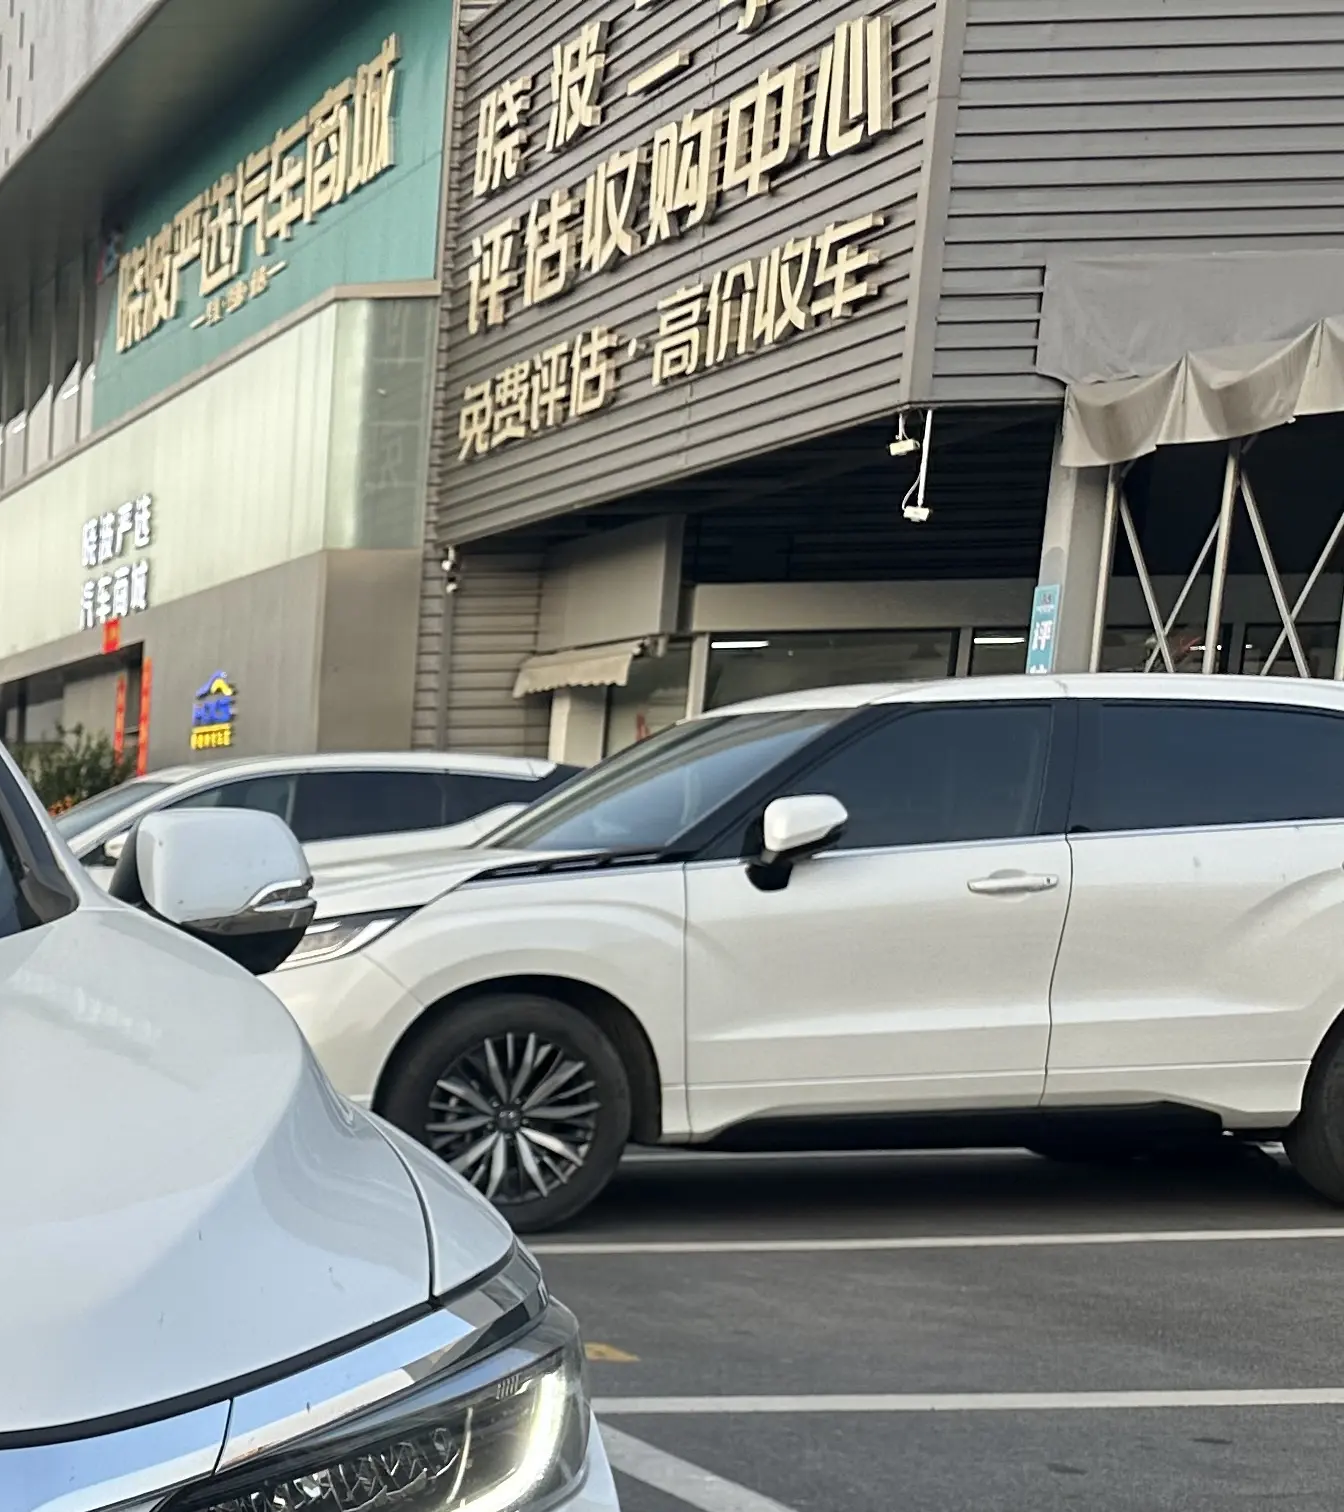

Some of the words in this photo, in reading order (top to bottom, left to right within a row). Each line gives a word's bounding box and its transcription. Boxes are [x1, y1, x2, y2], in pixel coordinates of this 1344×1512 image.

[116, 32, 401, 354] 晓波严选汽车商城
[467, 15, 900, 334] 评估收购中心
